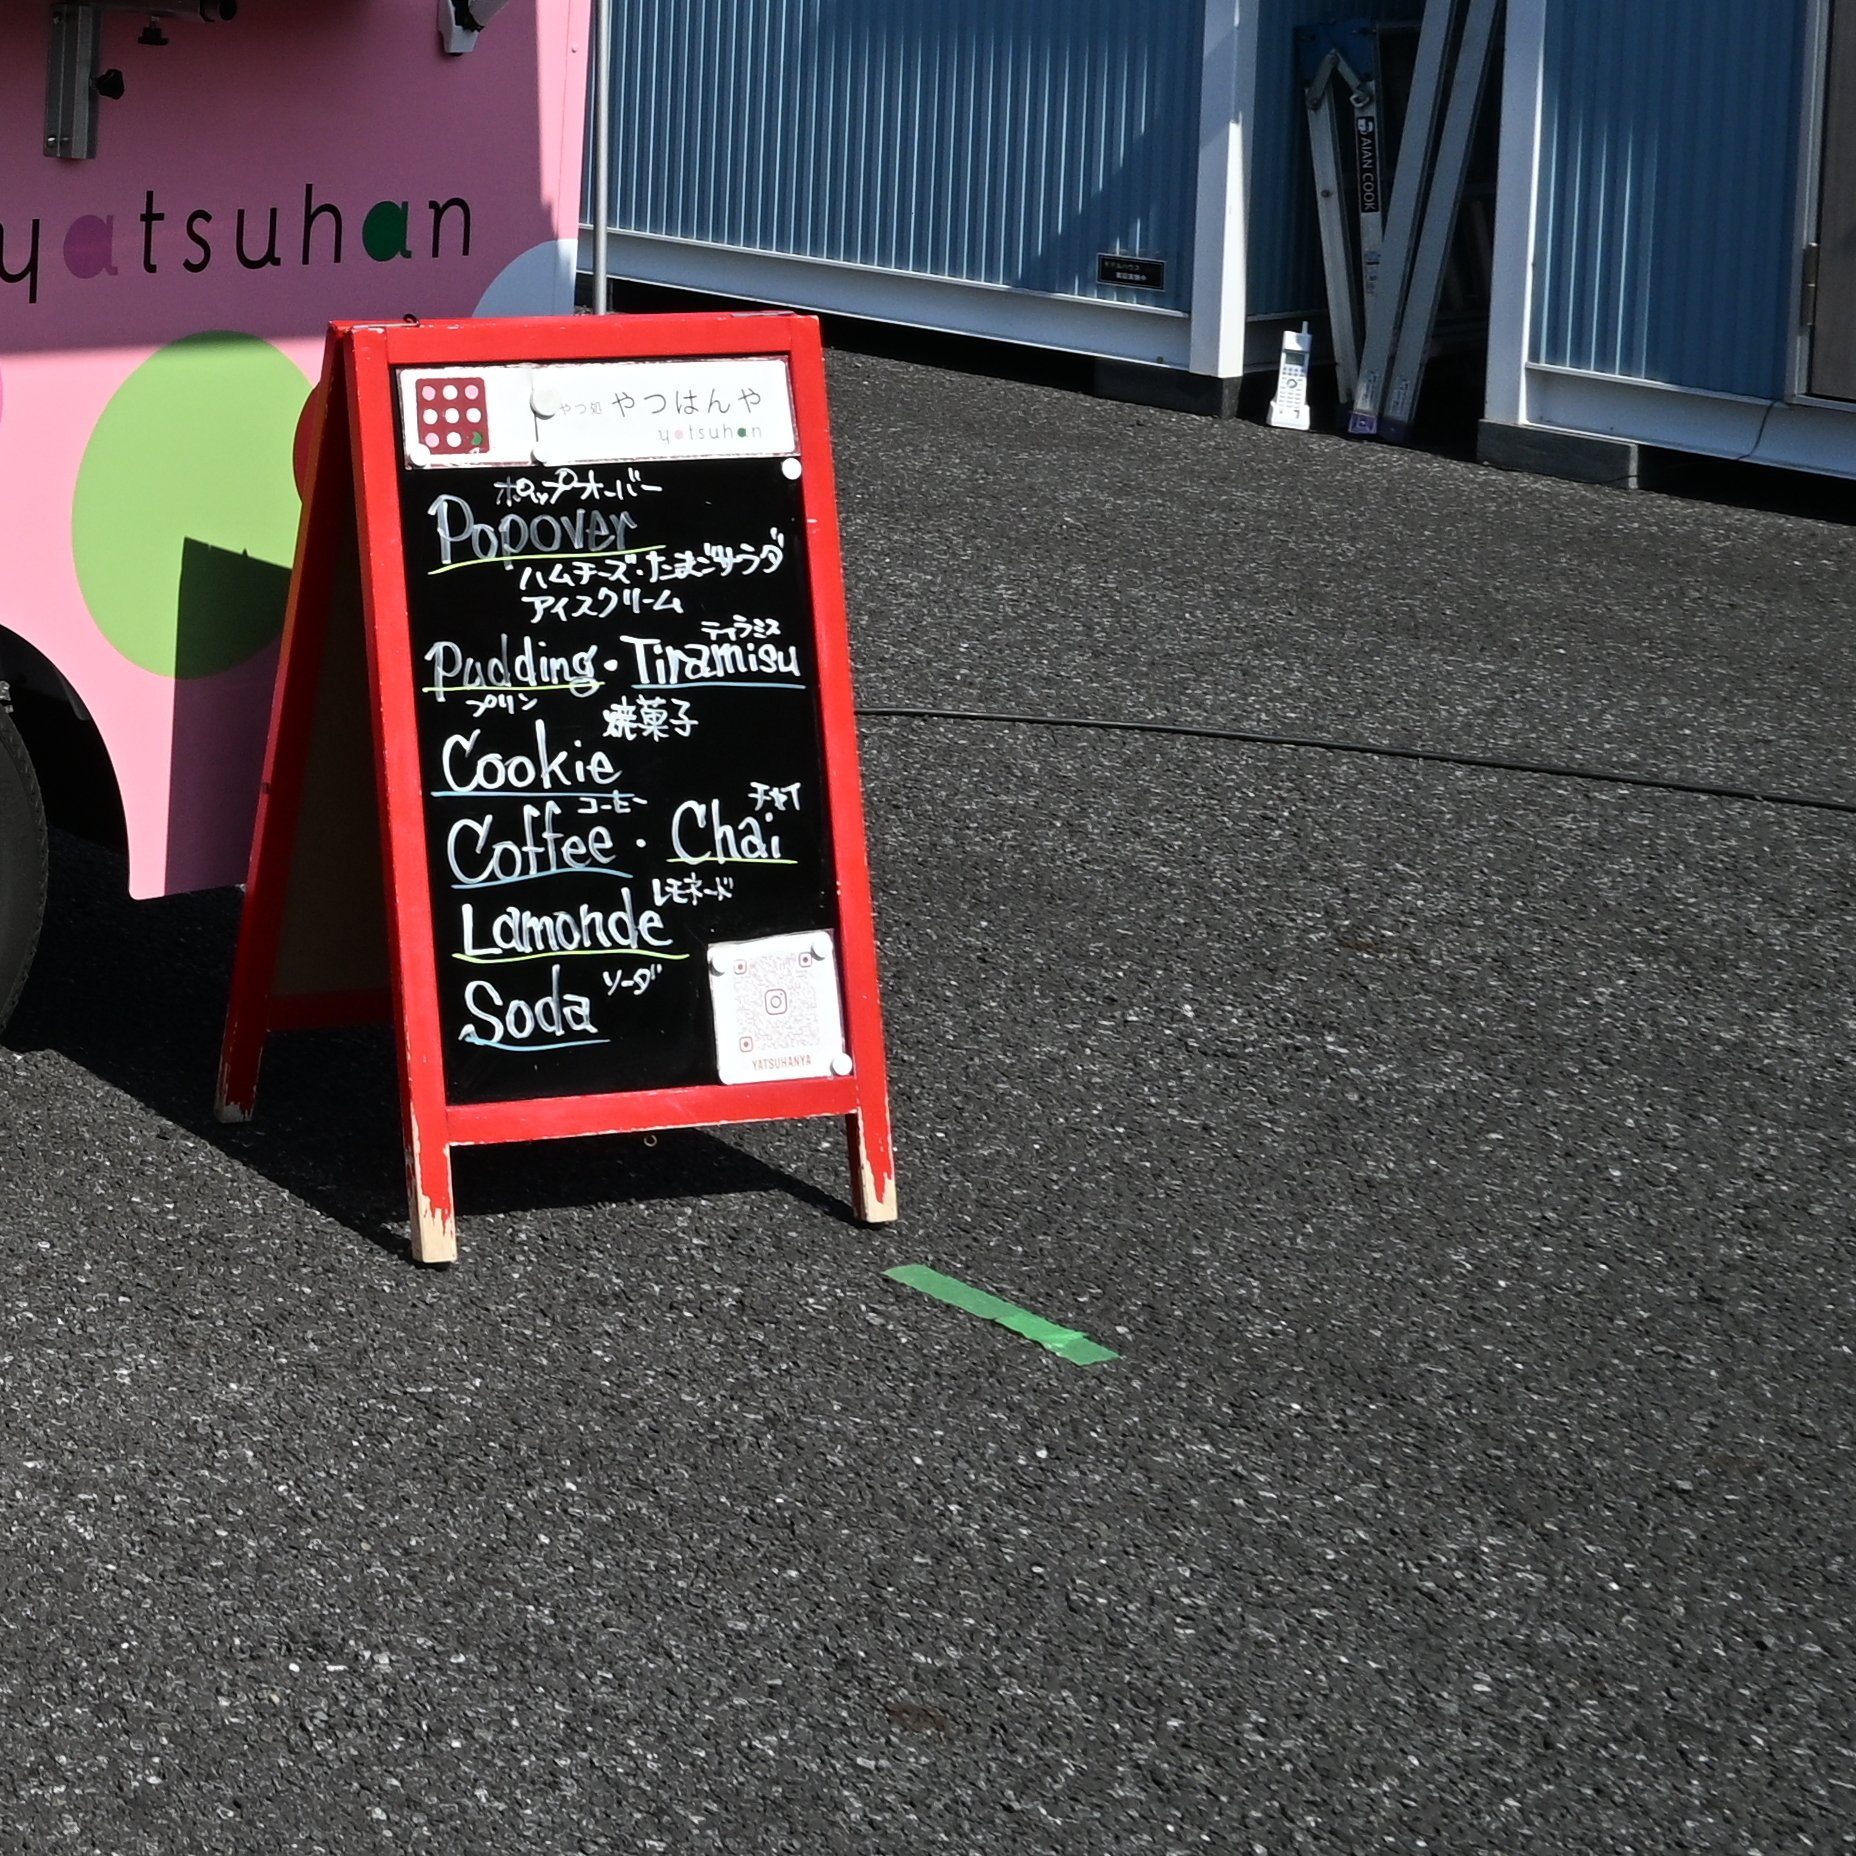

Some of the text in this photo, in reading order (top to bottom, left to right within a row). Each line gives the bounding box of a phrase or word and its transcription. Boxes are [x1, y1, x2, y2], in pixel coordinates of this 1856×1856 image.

[1361, 172, 1373, 212] COOK
[611, 387, 761, 418] やつはんや
[658, 424, 762, 445] yatsuhan
[494, 467, 663, 506] ポップオーバー
[428, 494, 638, 571] Popover
[520, 587, 684, 625] アイスクリーム
[701, 614, 781, 642] ティラミス
[425, 633, 801, 703] Pudding Tiramisu
[465, 693, 538, 717] プリン
[602, 695, 699, 741] 焼菓子
[442, 718, 623, 793] Cookie
[576, 795, 648, 814] コーヒー
[747, 780, 801, 812] チャイ
[447, 798, 782, 883] Coffee Chai
[651, 872, 734, 907] レモネード
[602, 963, 664, 996] ソーダ
[458, 964, 599, 1045] Soda
[751, 1054, 813, 1071] YATSUHANYA
